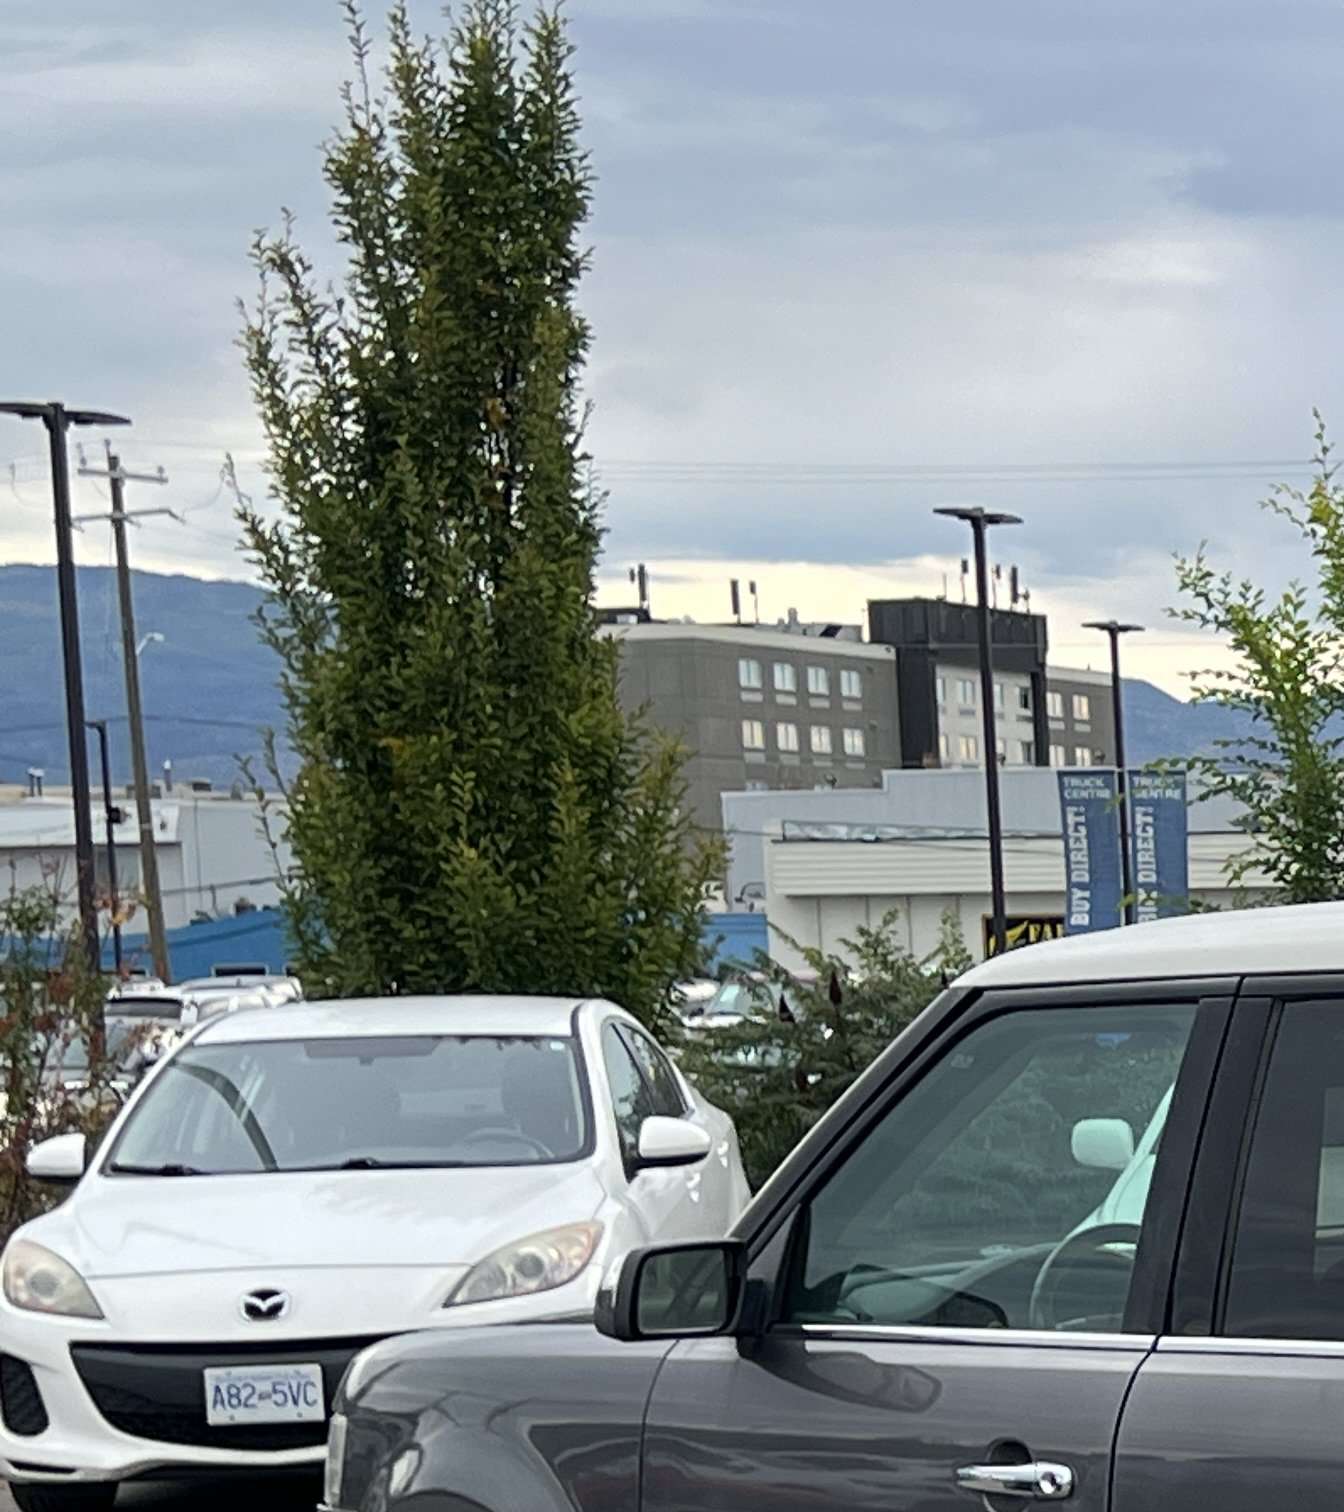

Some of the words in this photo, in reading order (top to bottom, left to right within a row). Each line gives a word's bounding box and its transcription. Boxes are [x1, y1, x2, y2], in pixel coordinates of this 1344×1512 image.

[1063, 776, 1104, 787] TRUCK
[1066, 805, 1090, 883] DIRECT!
[1135, 805, 1158, 883] DIRECT!
[1069, 888, 1091, 926] BUY
